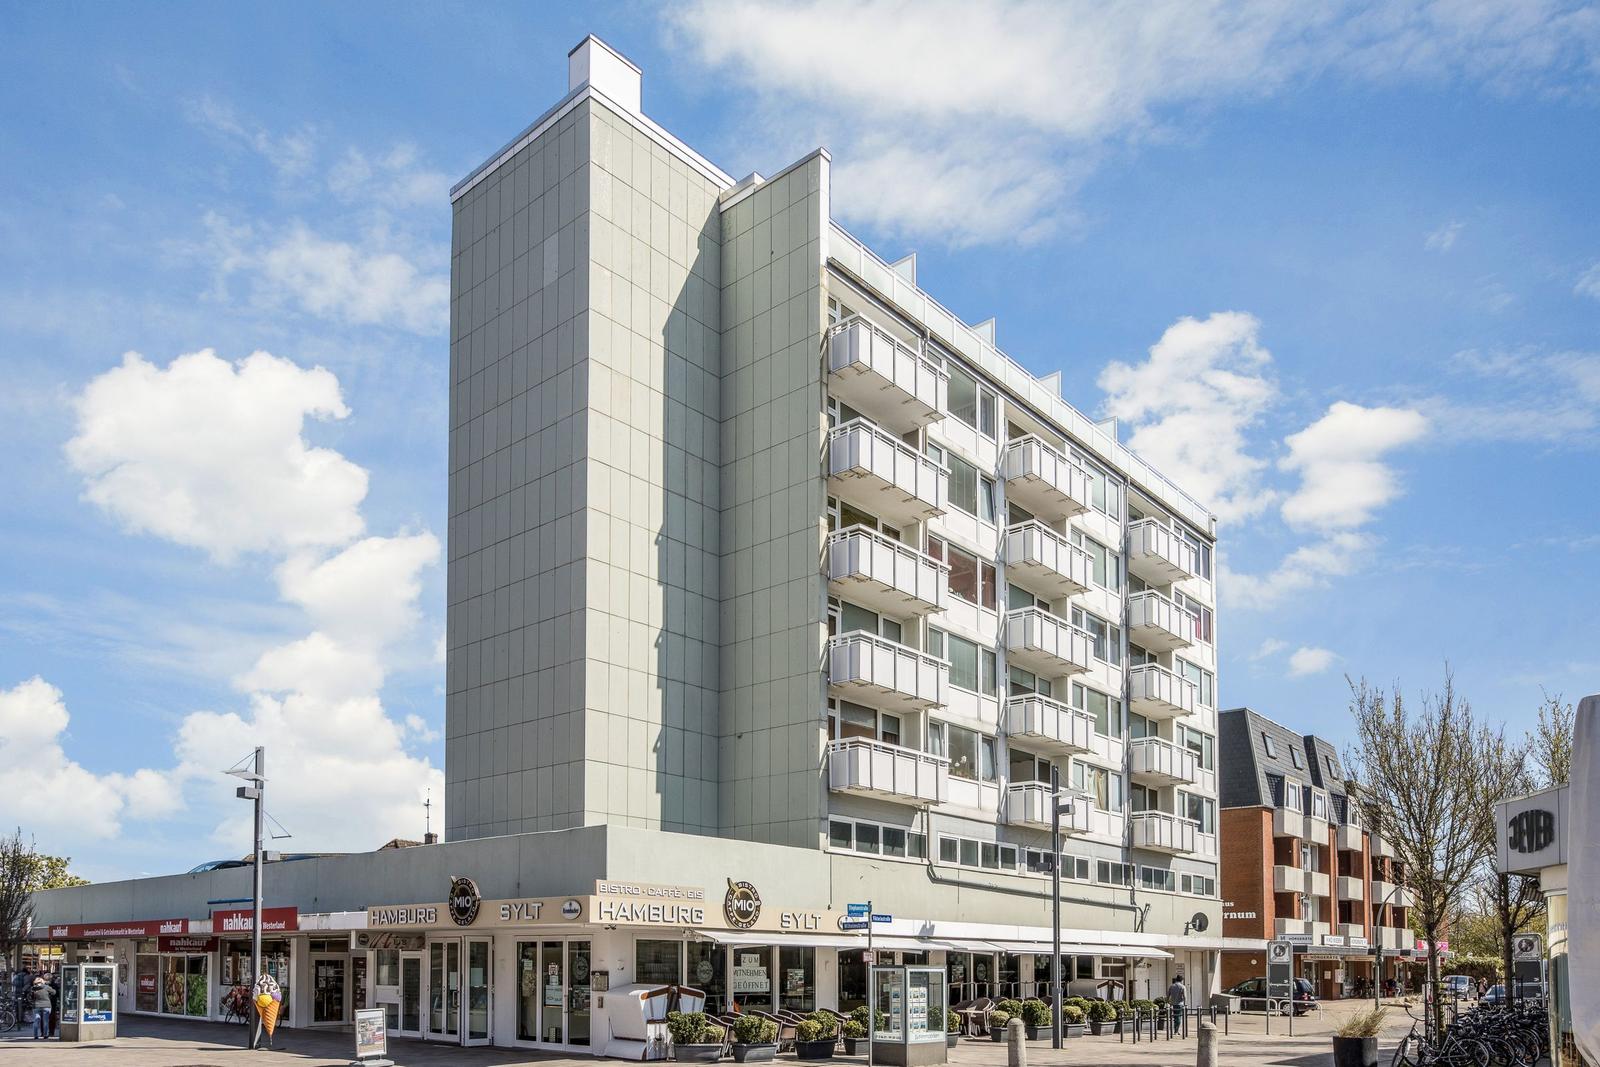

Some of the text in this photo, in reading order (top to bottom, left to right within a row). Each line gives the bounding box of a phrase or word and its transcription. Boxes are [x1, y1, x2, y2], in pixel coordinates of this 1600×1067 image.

[600, 883, 704, 899] BISTRO CAFFÈ EIS
[454, 896, 471, 908] MIO
[734, 899, 754, 911] MIO
[371, 902, 543, 925] HAMBURG SYLT
[599, 901, 704, 925] HAMBURG
[780, 912, 822, 930] SYLT
[52, 926, 68, 937] nahkauf
[160, 920, 182, 934] nahkauf
[223, 913, 254, 931] nahkau
[262, 920, 286, 930] Westerland
[169, 937, 208, 947] nahkauf
[742, 956, 759, 964] ZUM
